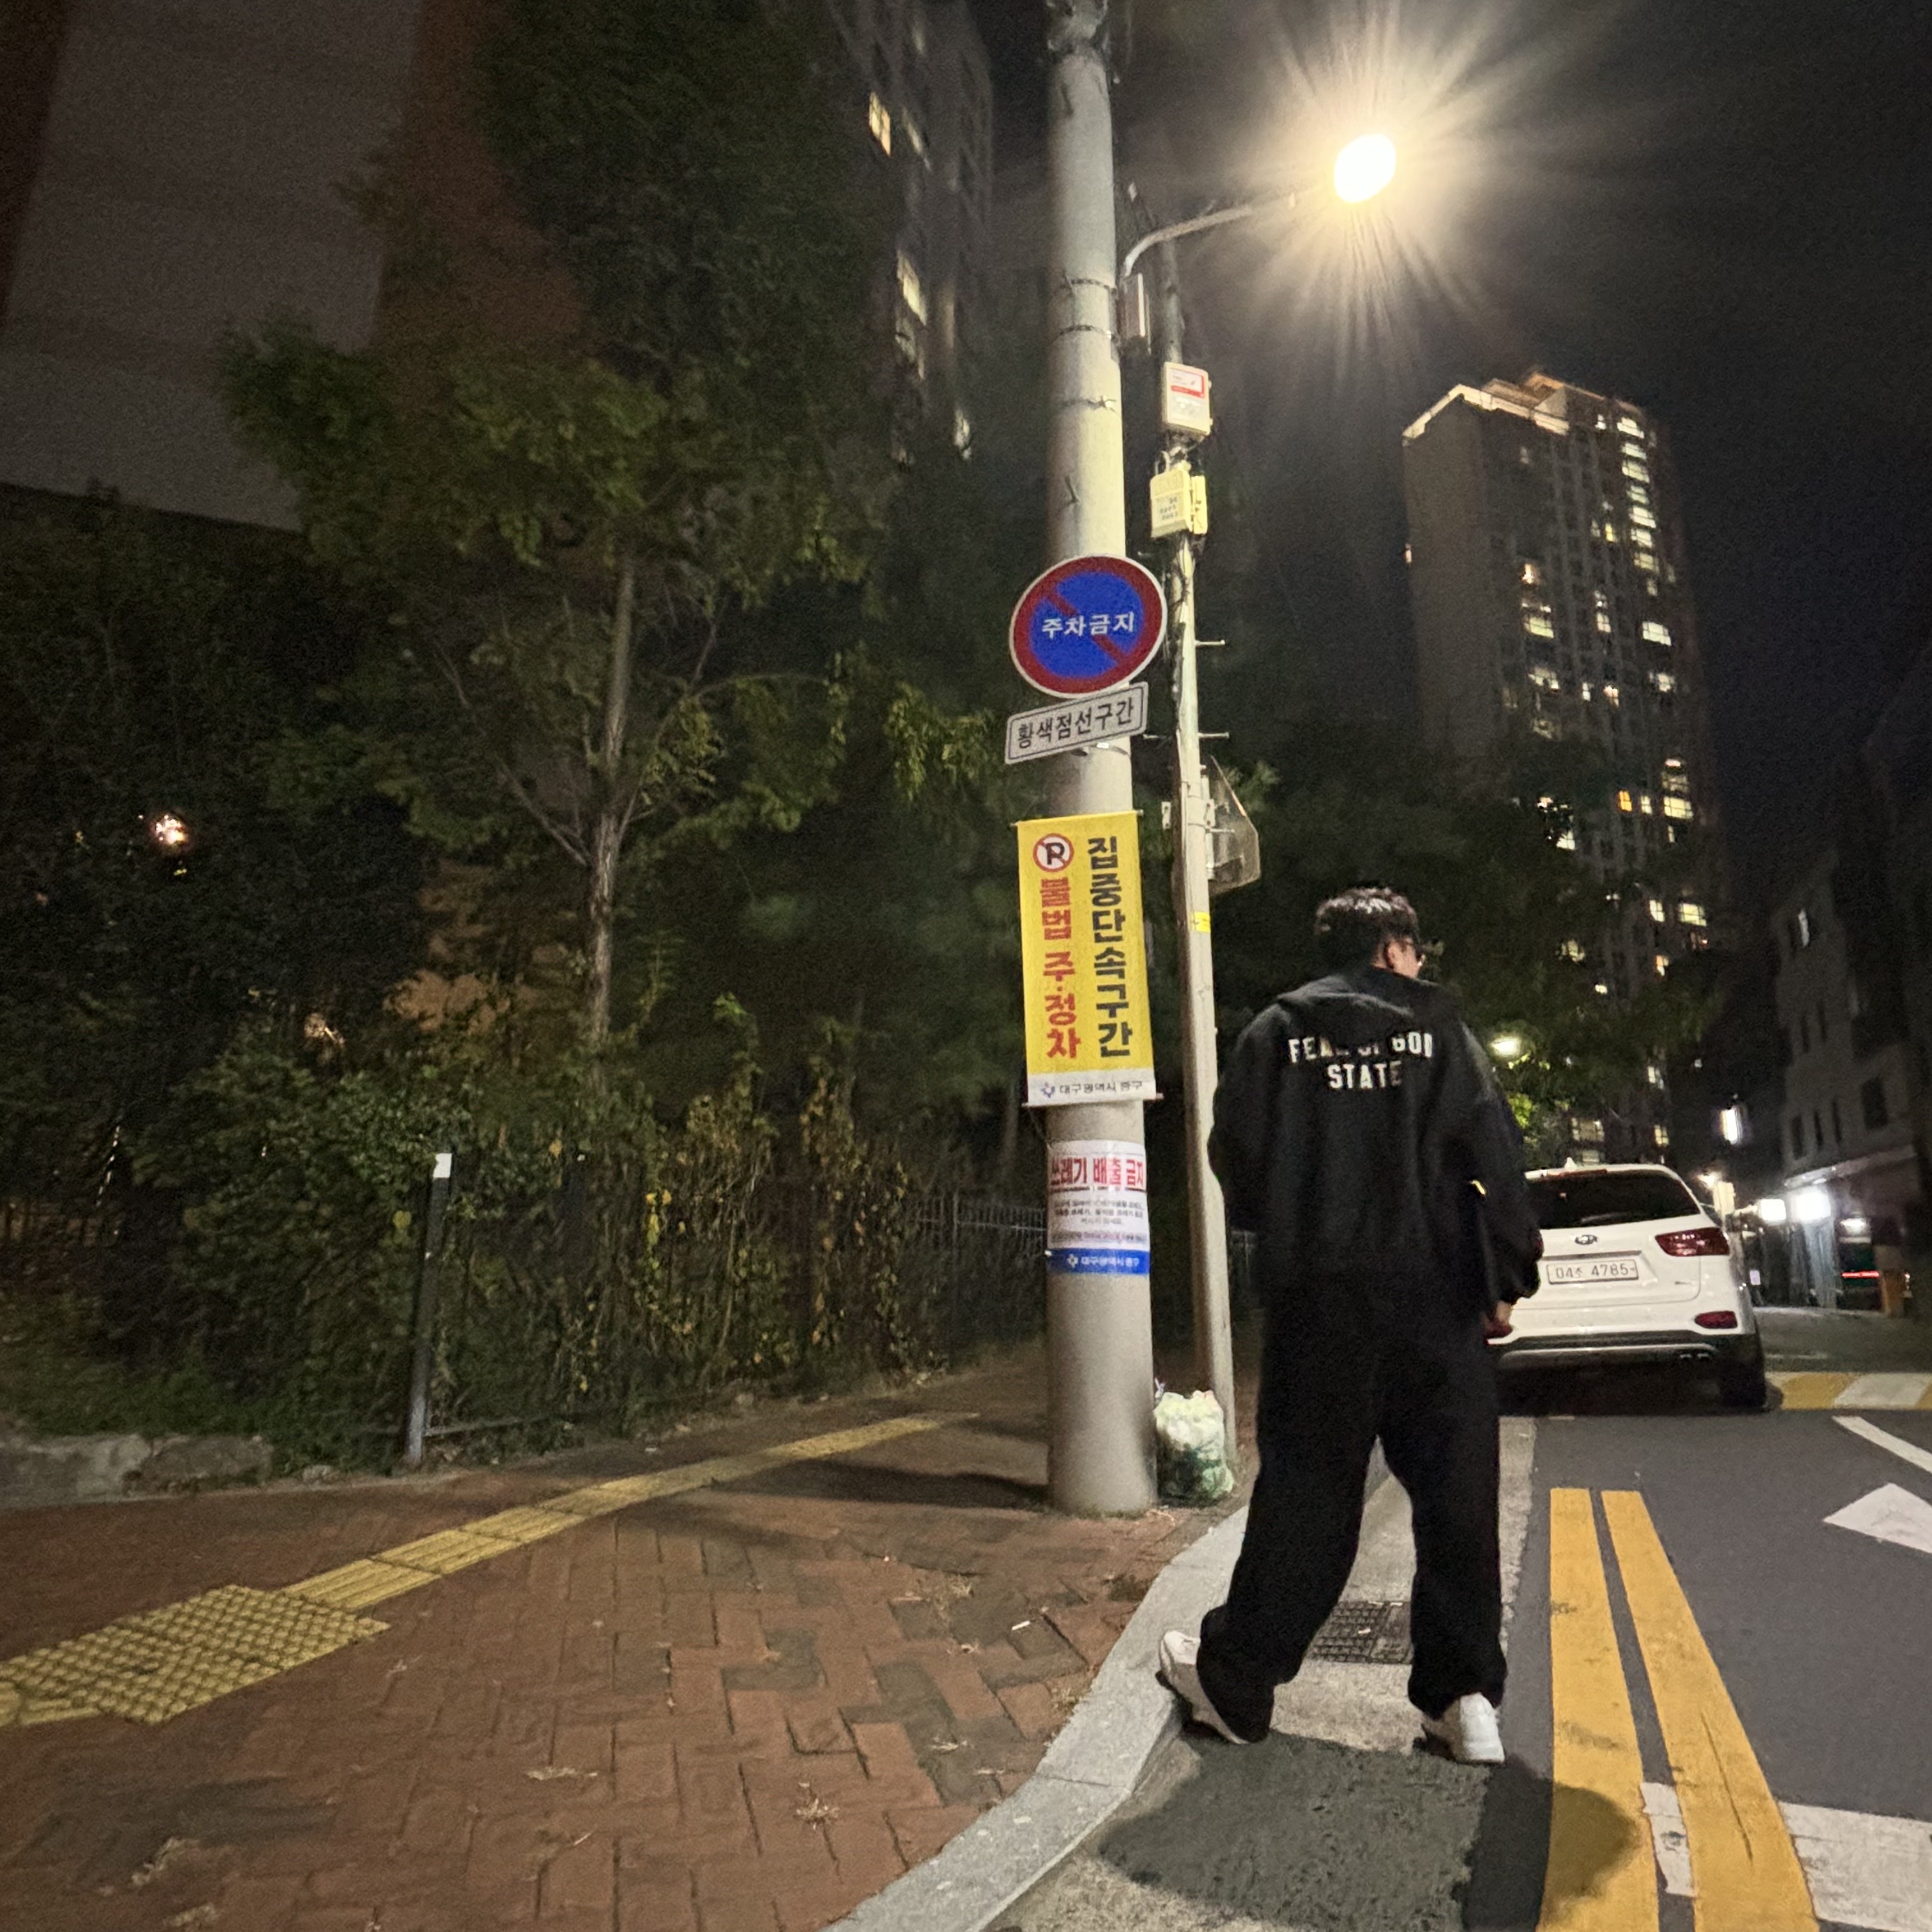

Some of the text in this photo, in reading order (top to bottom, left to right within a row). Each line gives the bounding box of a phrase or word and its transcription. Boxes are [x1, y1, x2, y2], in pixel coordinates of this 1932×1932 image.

[1041, 611, 1135, 640] 주차금지
[1017, 696, 1135, 749] 황색점선구간
[1040, 877, 1072, 940] 불법
[1087, 835, 1133, 1059] 집중단속구간
[1059, 1081, 1117, 1094] 대구광역시
[1327, 1061, 1402, 1089] STATE
[1093, 1156, 1121, 1185] 배출
[1591, 1262, 1629, 1276] 4785
